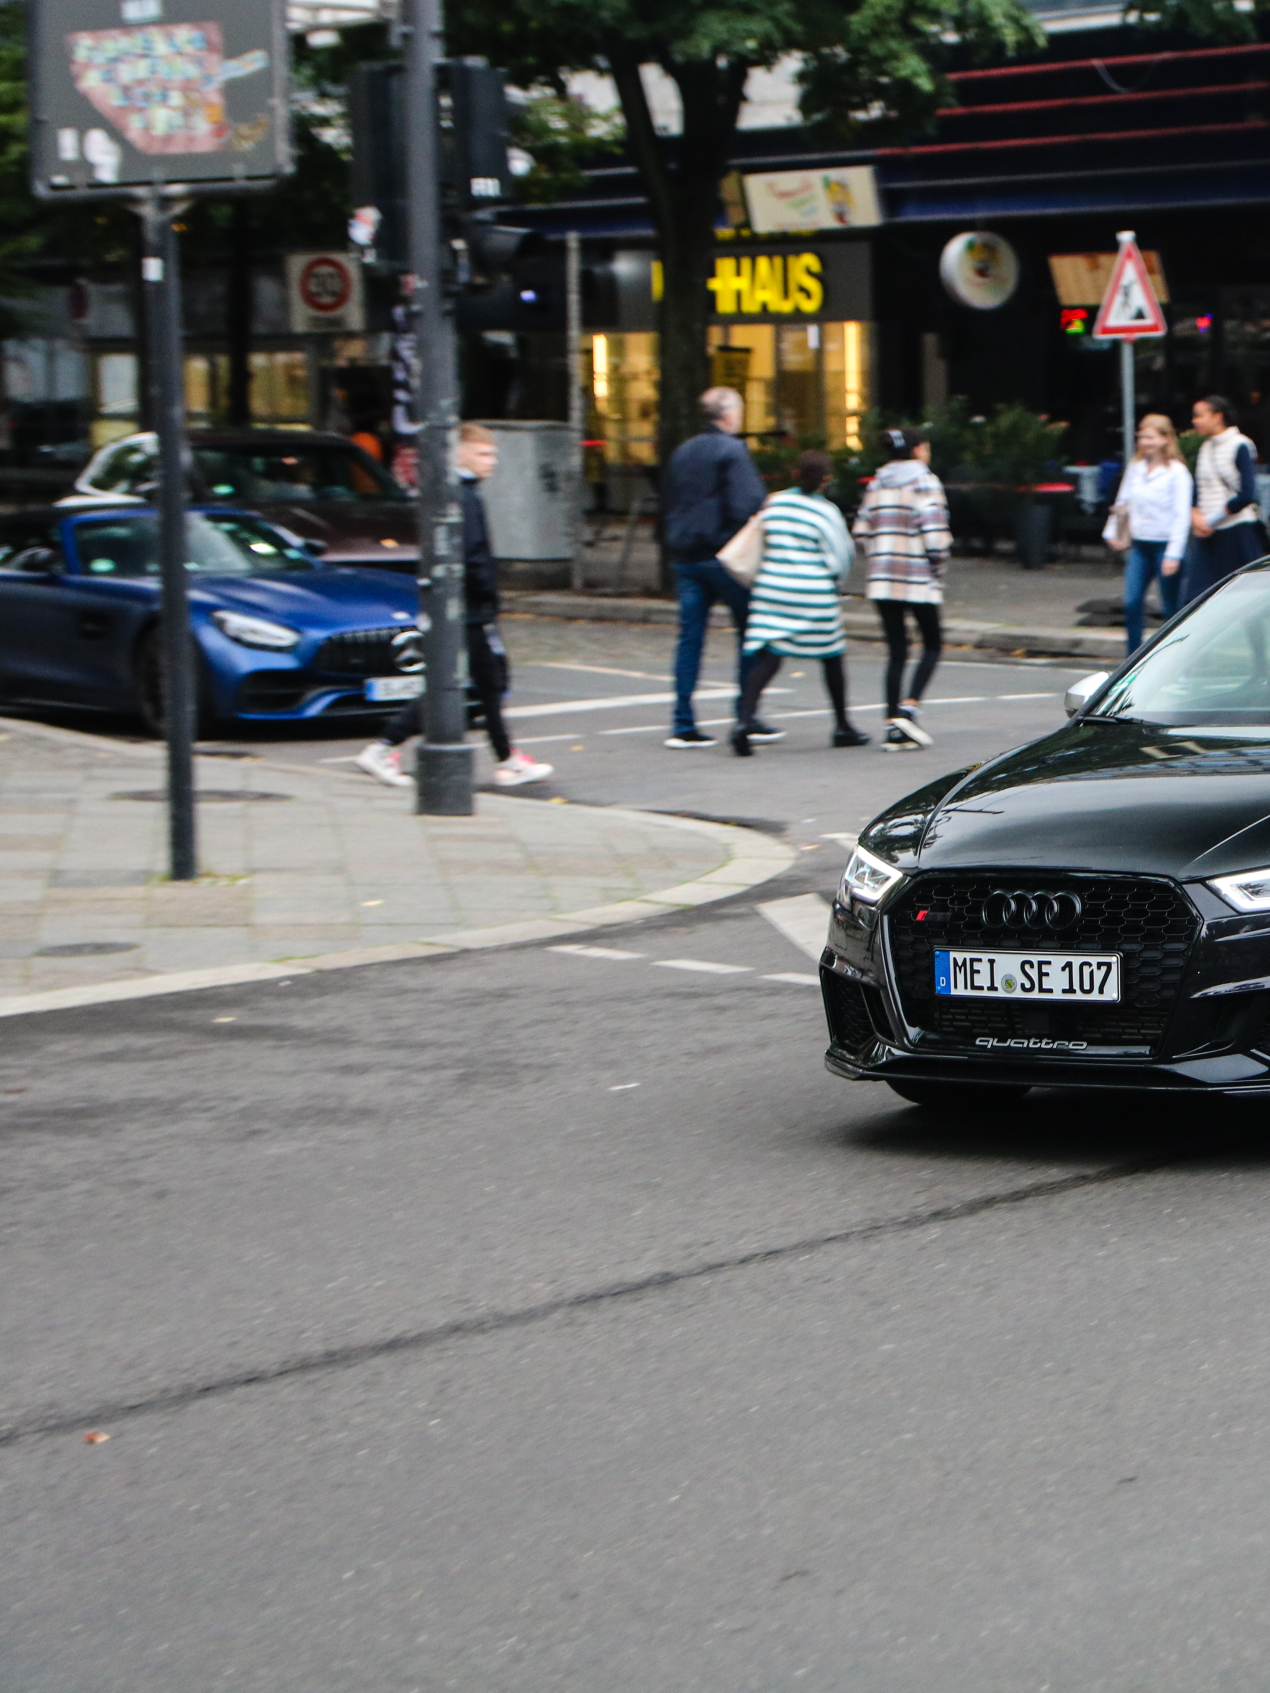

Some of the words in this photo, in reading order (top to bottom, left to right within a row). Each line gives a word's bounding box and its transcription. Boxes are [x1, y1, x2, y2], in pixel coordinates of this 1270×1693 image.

[940, 976, 946, 987] D
[953, 957, 998, 991] MEI
[1020, 960, 1053, 993] SE
[1061, 961, 1112, 994] 107
[975, 1036, 1088, 1049] quattro
